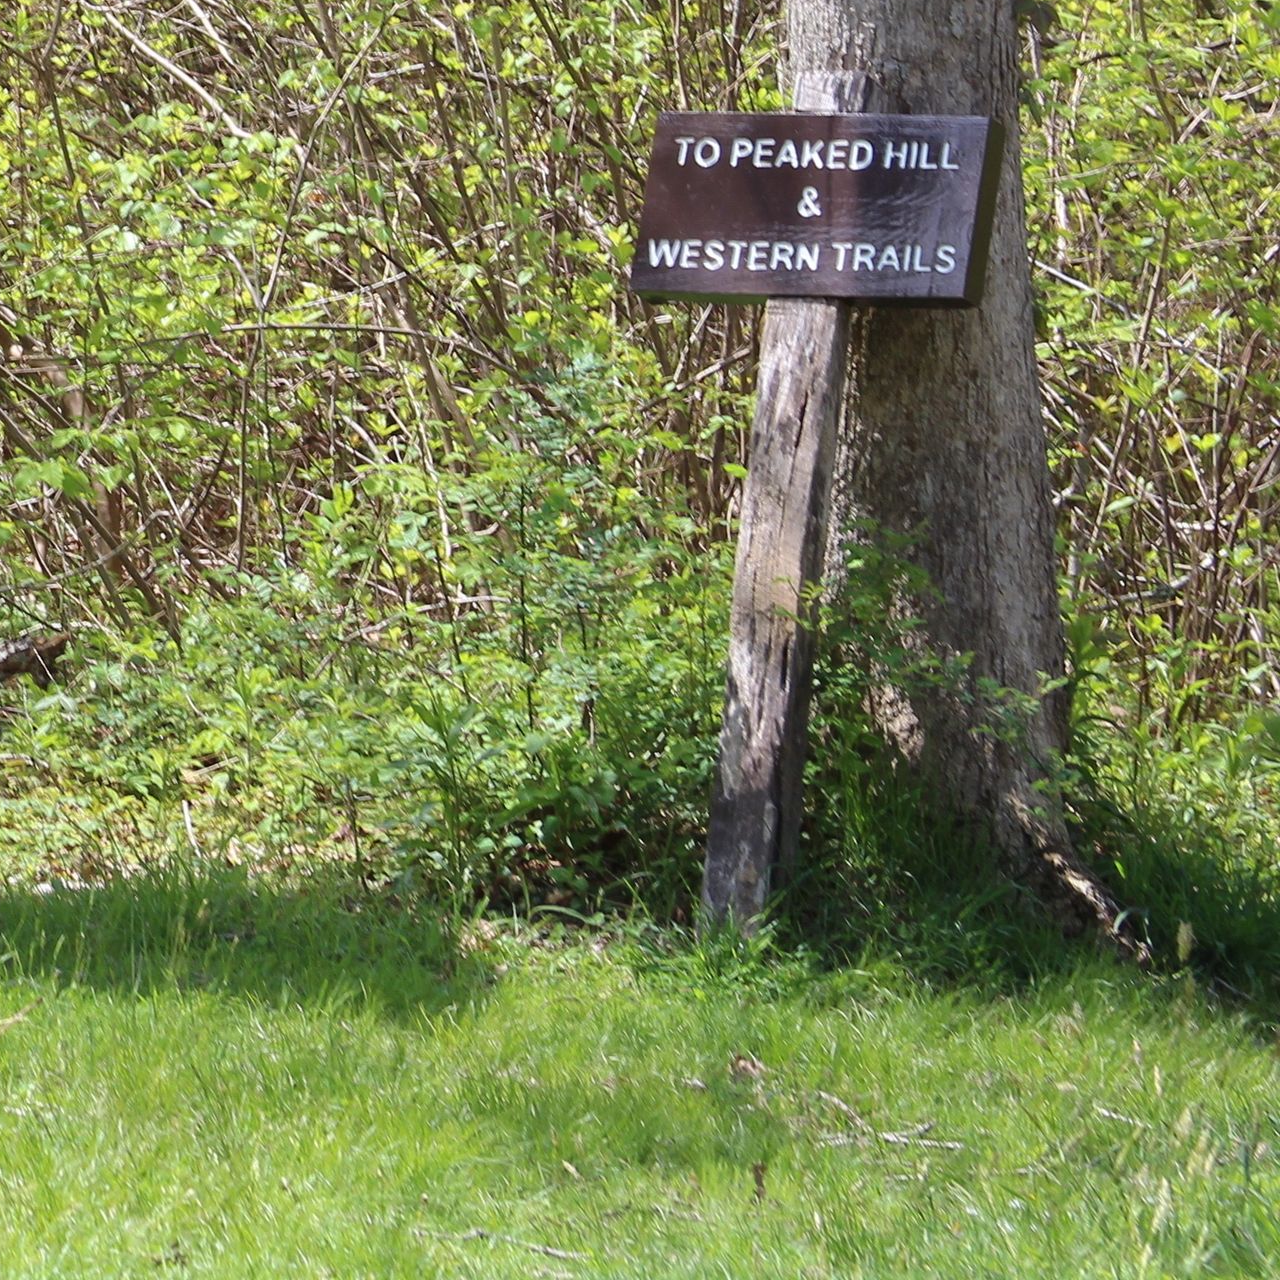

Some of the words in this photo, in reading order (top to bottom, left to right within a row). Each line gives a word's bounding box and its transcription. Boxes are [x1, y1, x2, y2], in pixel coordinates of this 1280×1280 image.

[675, 136, 721, 168] TO
[729, 138, 873, 171] PEAKED
[882, 140, 960, 170] HILL
[796, 186, 822, 218] &
[648, 239, 819, 272] WESTERN
[832, 242, 956, 274] TRAILS
